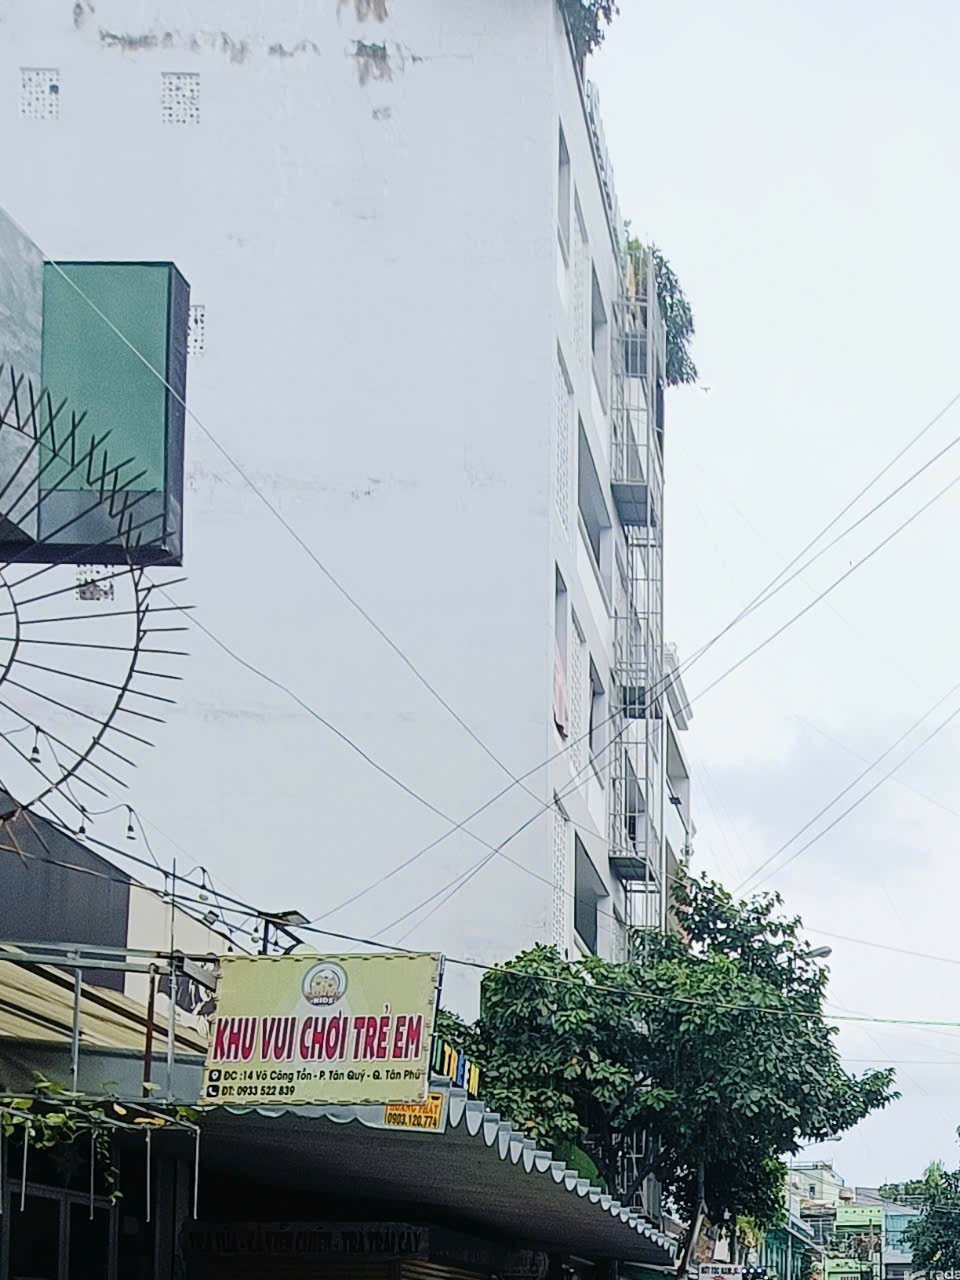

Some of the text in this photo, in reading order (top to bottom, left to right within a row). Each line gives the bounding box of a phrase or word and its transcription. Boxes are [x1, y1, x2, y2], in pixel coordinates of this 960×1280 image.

[313, 996, 333, 1004] KIDS
[213, 1004, 423, 1061] KHU VUI CHƠI TRẺ EM
[270, 1070, 294, 1083] Công
[319, 1070, 326, 1081] P.
[372, 1070, 382, 1080] Q.
[237, 1085, 258, 1096] 0933
[260, 1085, 276, 1096] 522
[278, 1085, 295, 1096] 839
[387, 1112, 438, 1128] 0903.120.774
